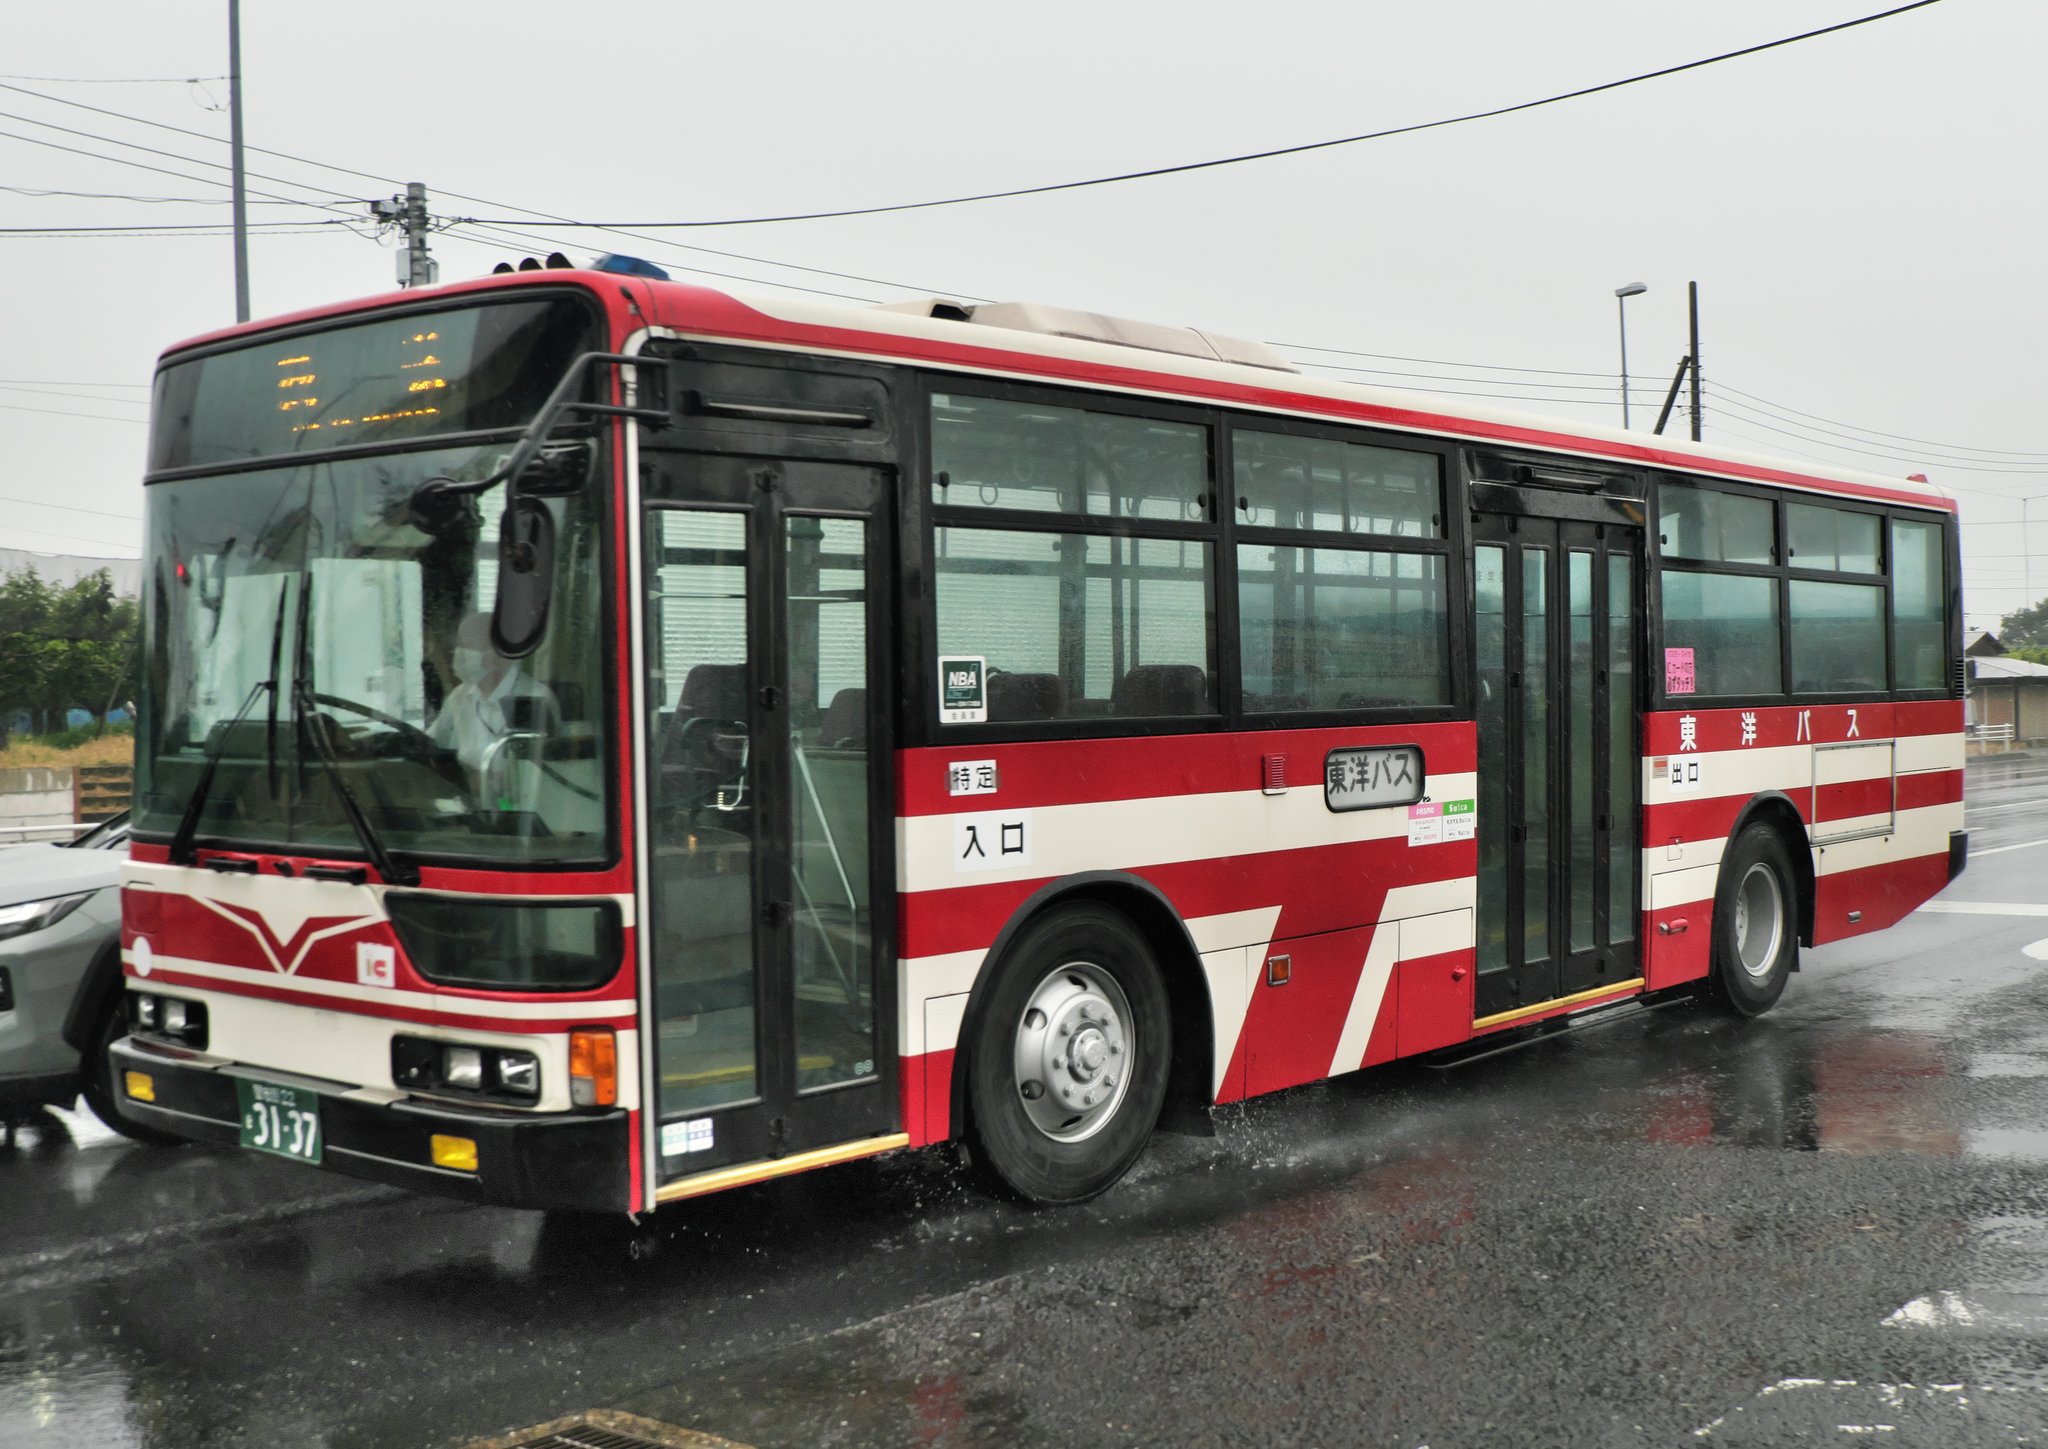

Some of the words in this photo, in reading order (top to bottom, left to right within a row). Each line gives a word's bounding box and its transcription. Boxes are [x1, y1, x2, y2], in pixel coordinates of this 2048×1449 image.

[949, 671, 977, 686] NBA
[1679, 709, 1860, 751] 東洋バス
[954, 766, 995, 791] 特定
[1328, 753, 1413, 796] 東洋バス
[1672, 762, 1698, 784] 出口
[963, 821, 1024, 859] 入口
